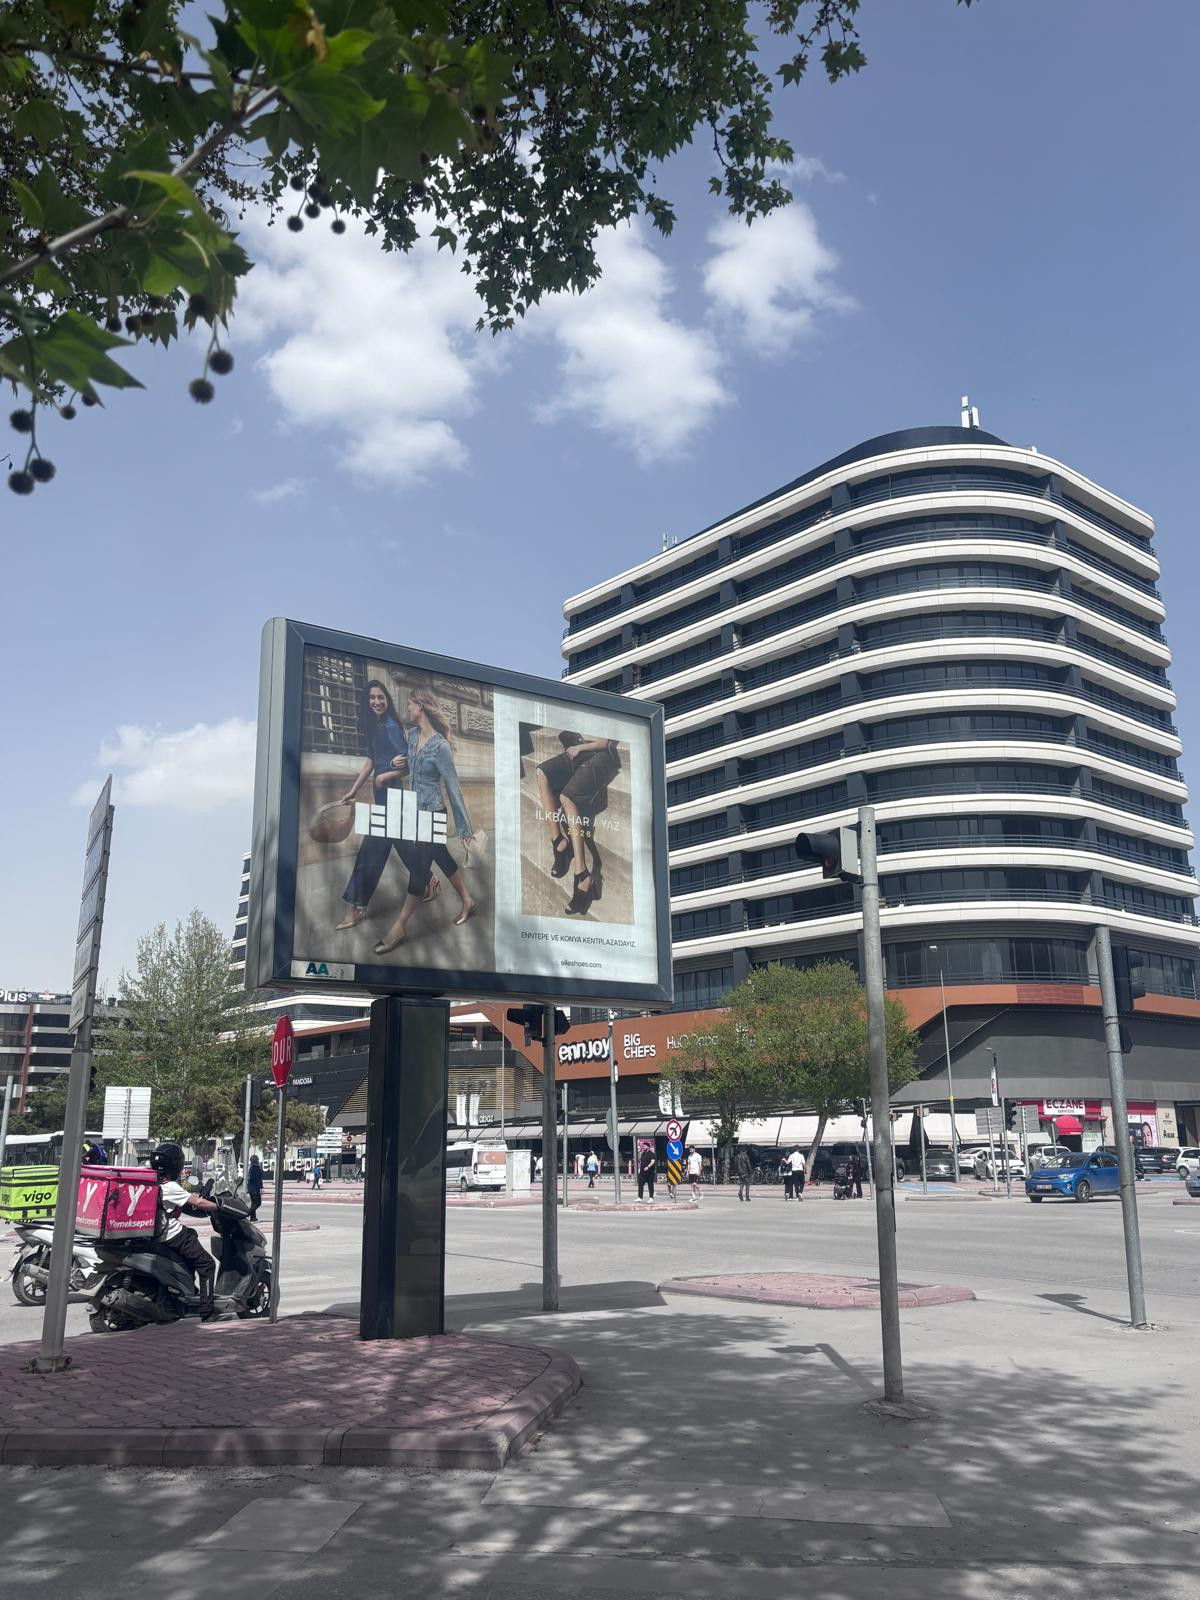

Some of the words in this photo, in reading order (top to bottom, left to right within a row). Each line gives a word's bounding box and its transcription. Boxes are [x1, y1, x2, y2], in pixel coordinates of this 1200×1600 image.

[601, 819, 620, 831] YAZ
[567, 828, 591, 838] 2026
[520, 932, 550, 941] ENNTEPE
[560, 960, 602, 969] elleshoes.com
[623, 1034, 641, 1047] BIG
[273, 1037, 292, 1066] DUR
[623, 1045, 656, 1059] CHEFS
[292, 1077, 313, 1085] PANDORA
[1046, 1099, 1084, 1109] ECZANE
[22, 1190, 52, 1204] vigo
